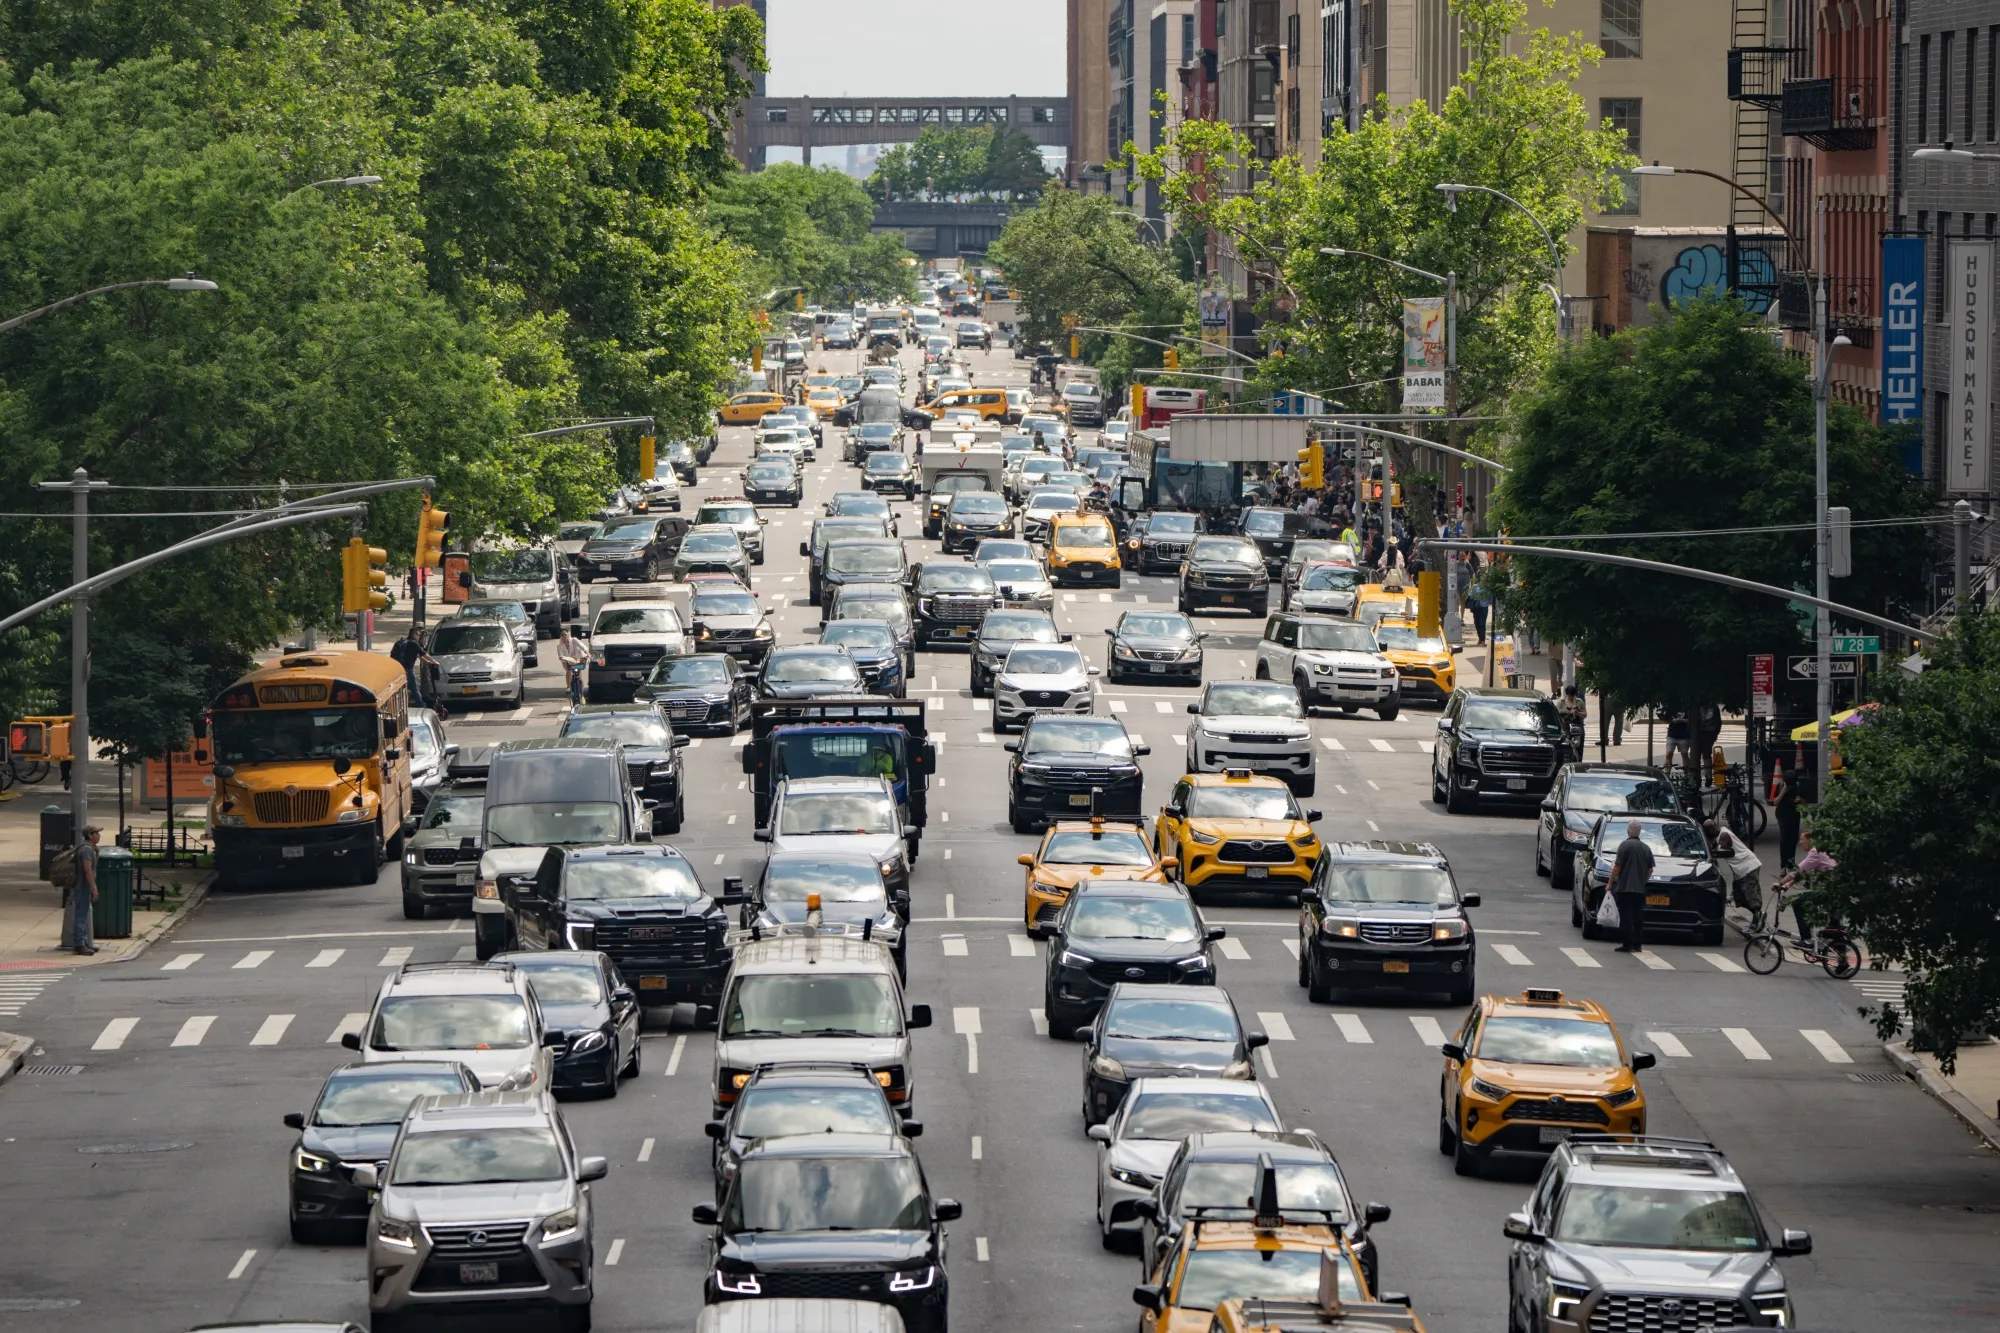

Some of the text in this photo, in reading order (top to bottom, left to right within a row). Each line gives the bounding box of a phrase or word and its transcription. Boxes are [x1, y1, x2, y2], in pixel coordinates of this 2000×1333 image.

[1887, 280, 1918, 424] HELLER
[1962, 255, 1977, 478] HUDSON MARKET
[1406, 377, 1442, 387] BABAR
[1834, 638, 1877, 652] W 28 ST
[1801, 662, 1851, 673] ONE WAY
[632, 929, 674, 939] GMC
[1257, 1216, 1282, 1228] 9N63
